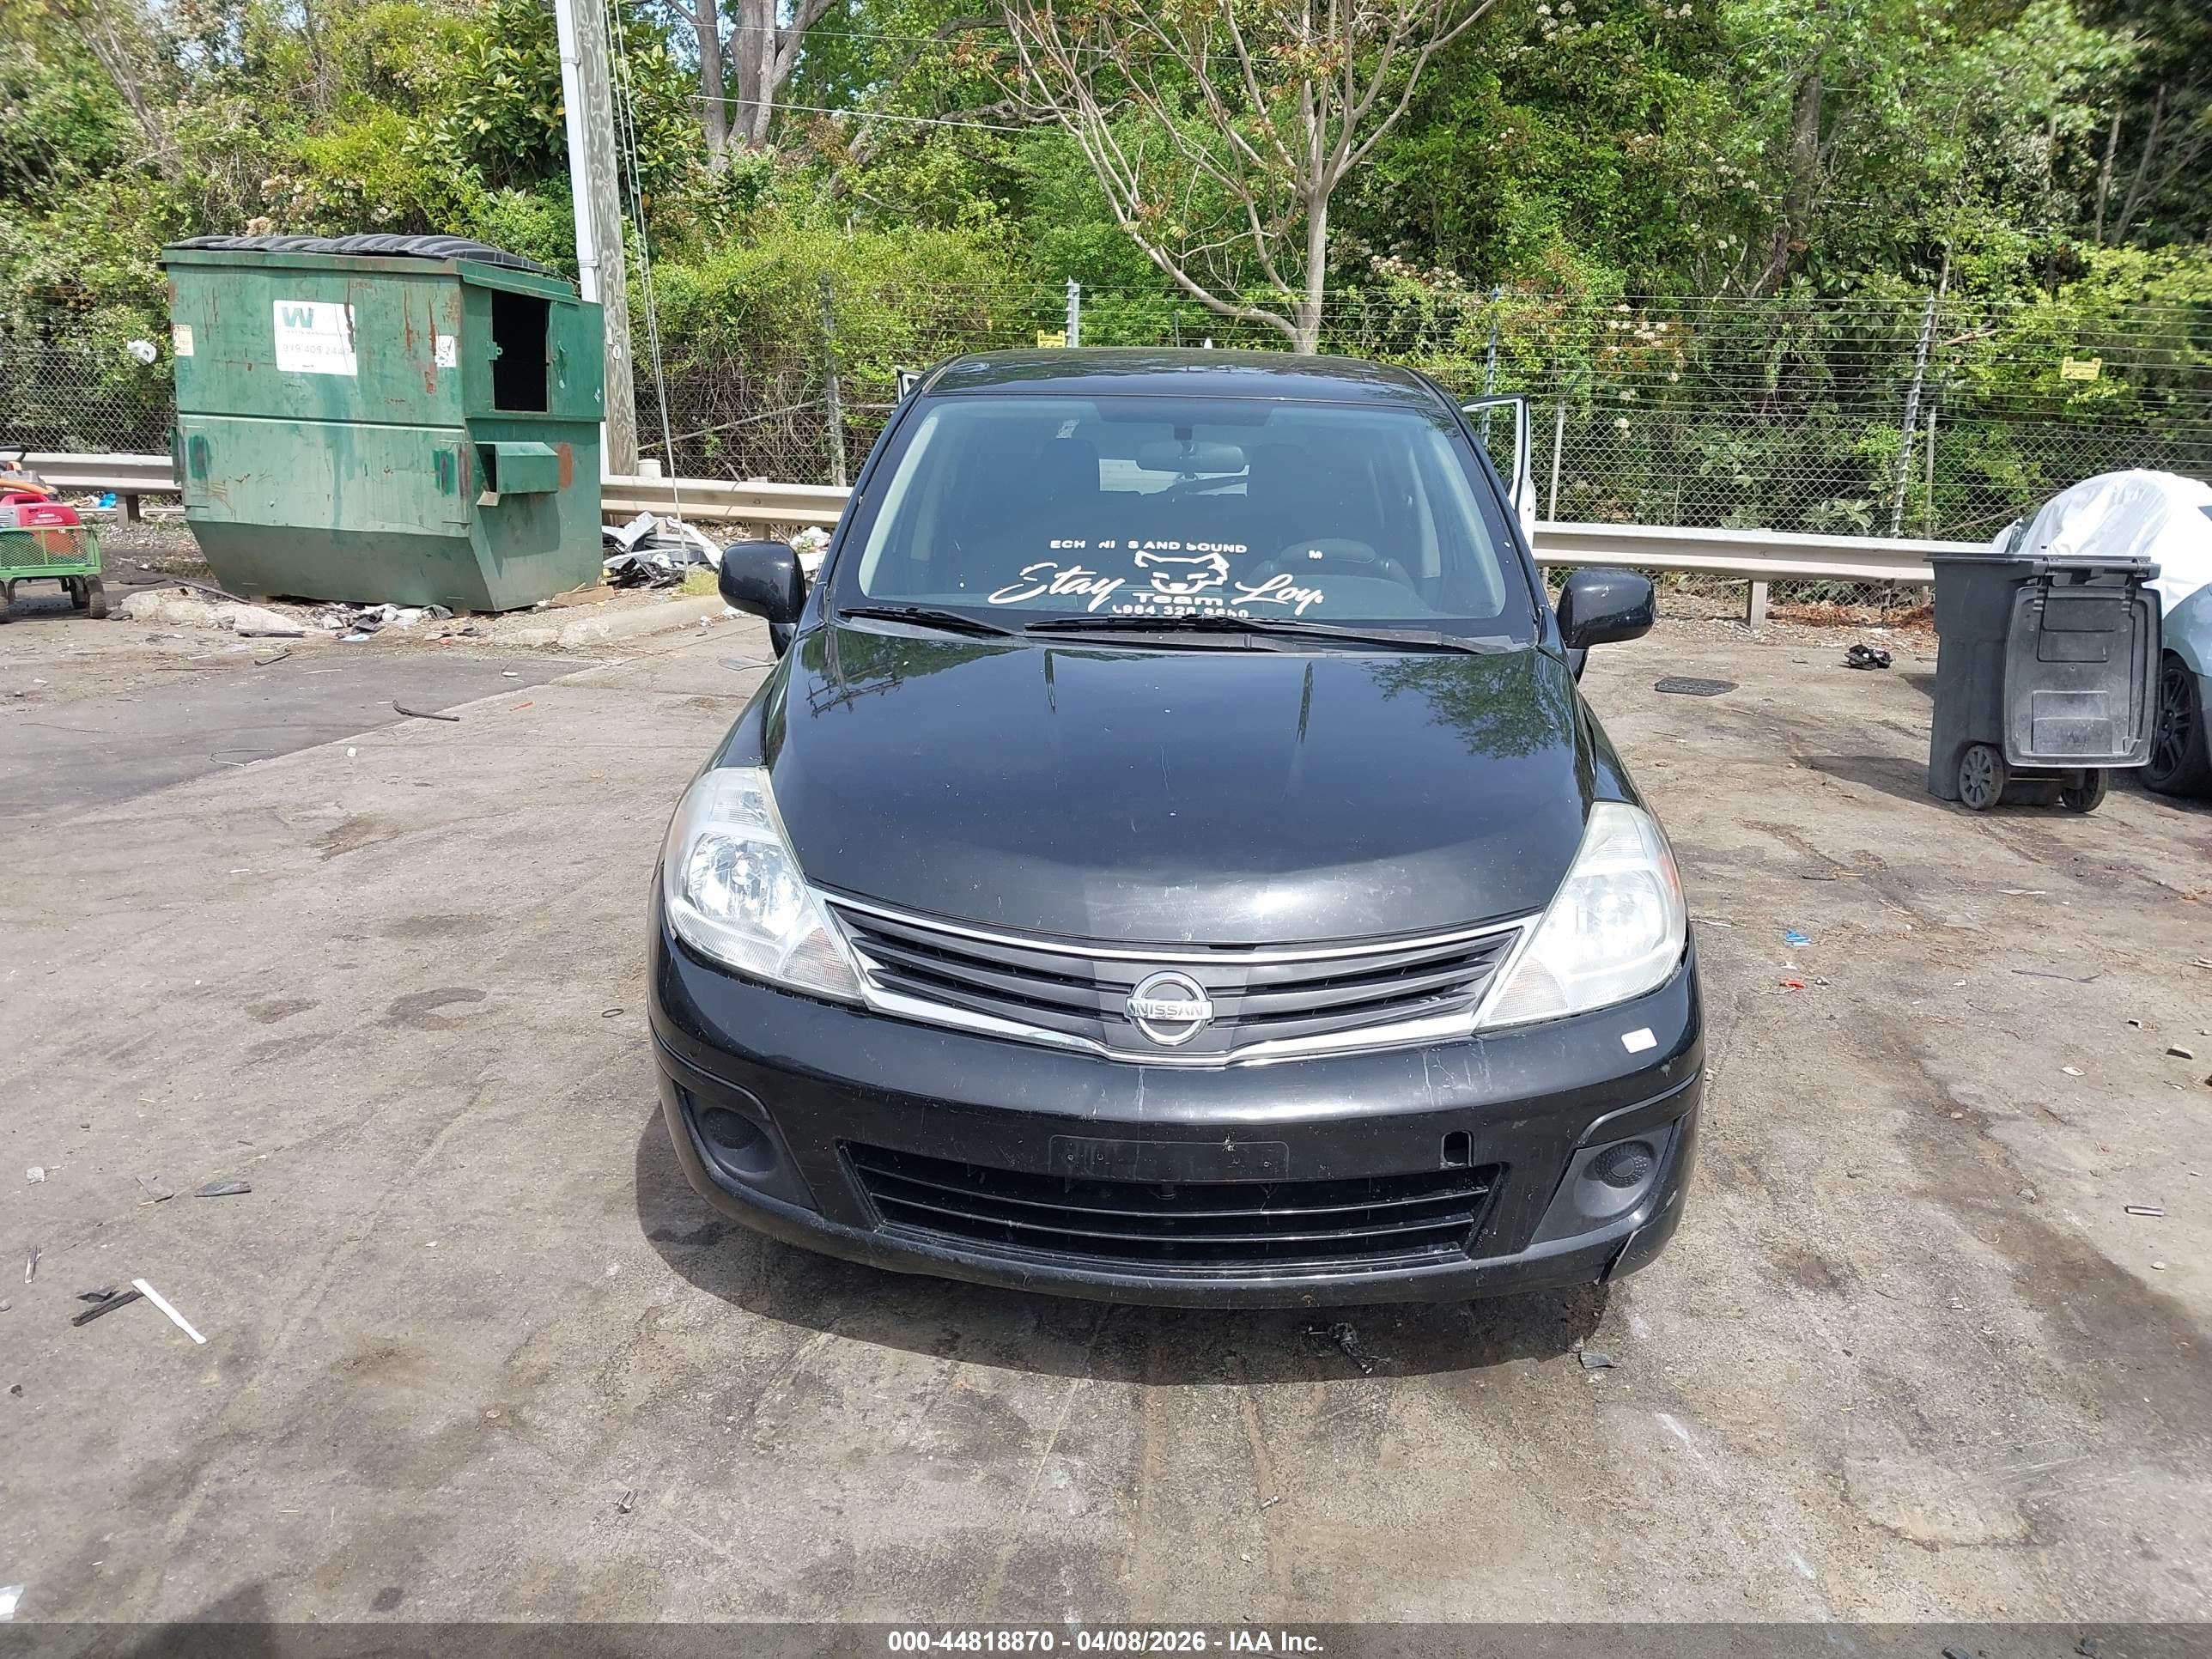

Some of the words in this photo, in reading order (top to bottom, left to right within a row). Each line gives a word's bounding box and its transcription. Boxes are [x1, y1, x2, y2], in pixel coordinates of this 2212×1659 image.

[1143, 541, 1181, 550] AND
[988, 562, 1126, 613] Stay
[1132, 592, 1224, 606] Team
[1134, 1002, 1203, 1017] NISSAN
